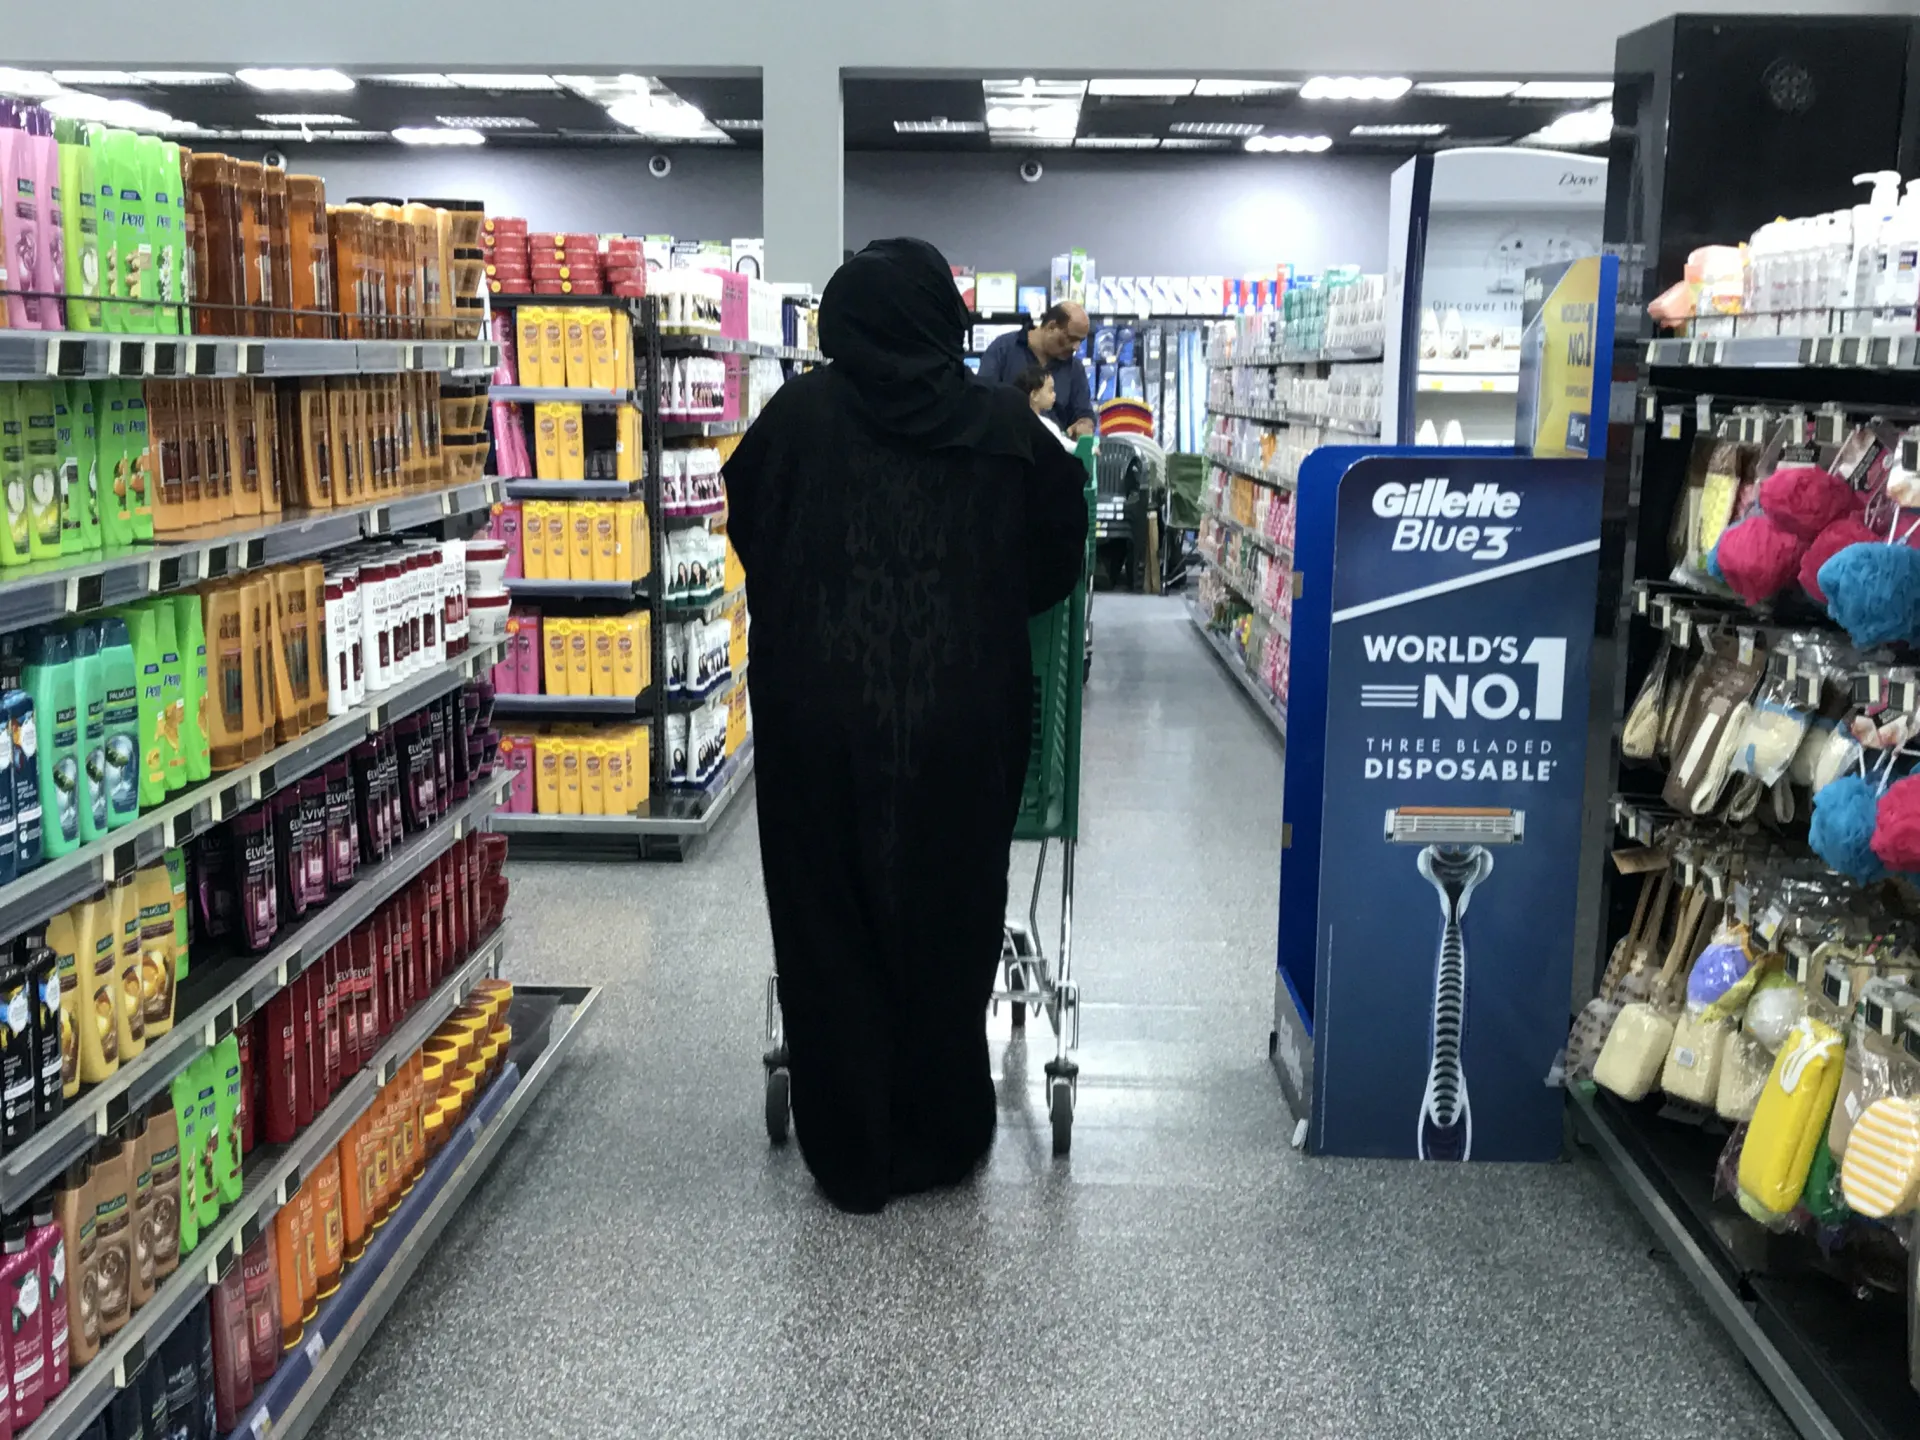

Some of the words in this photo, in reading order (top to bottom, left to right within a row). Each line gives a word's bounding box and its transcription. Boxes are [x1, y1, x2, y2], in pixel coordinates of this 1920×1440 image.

[1558, 170, 1599, 187] Dove
[1432, 300, 1497, 312] Discover
[1372, 478, 1521, 518] Gillette
[1363, 635, 1518, 664] WORLD'S
[1366, 737, 1441, 754] THREE
[1457, 738, 1552, 755] BLADED
[1364, 757, 1551, 782] DISPOSABLE
